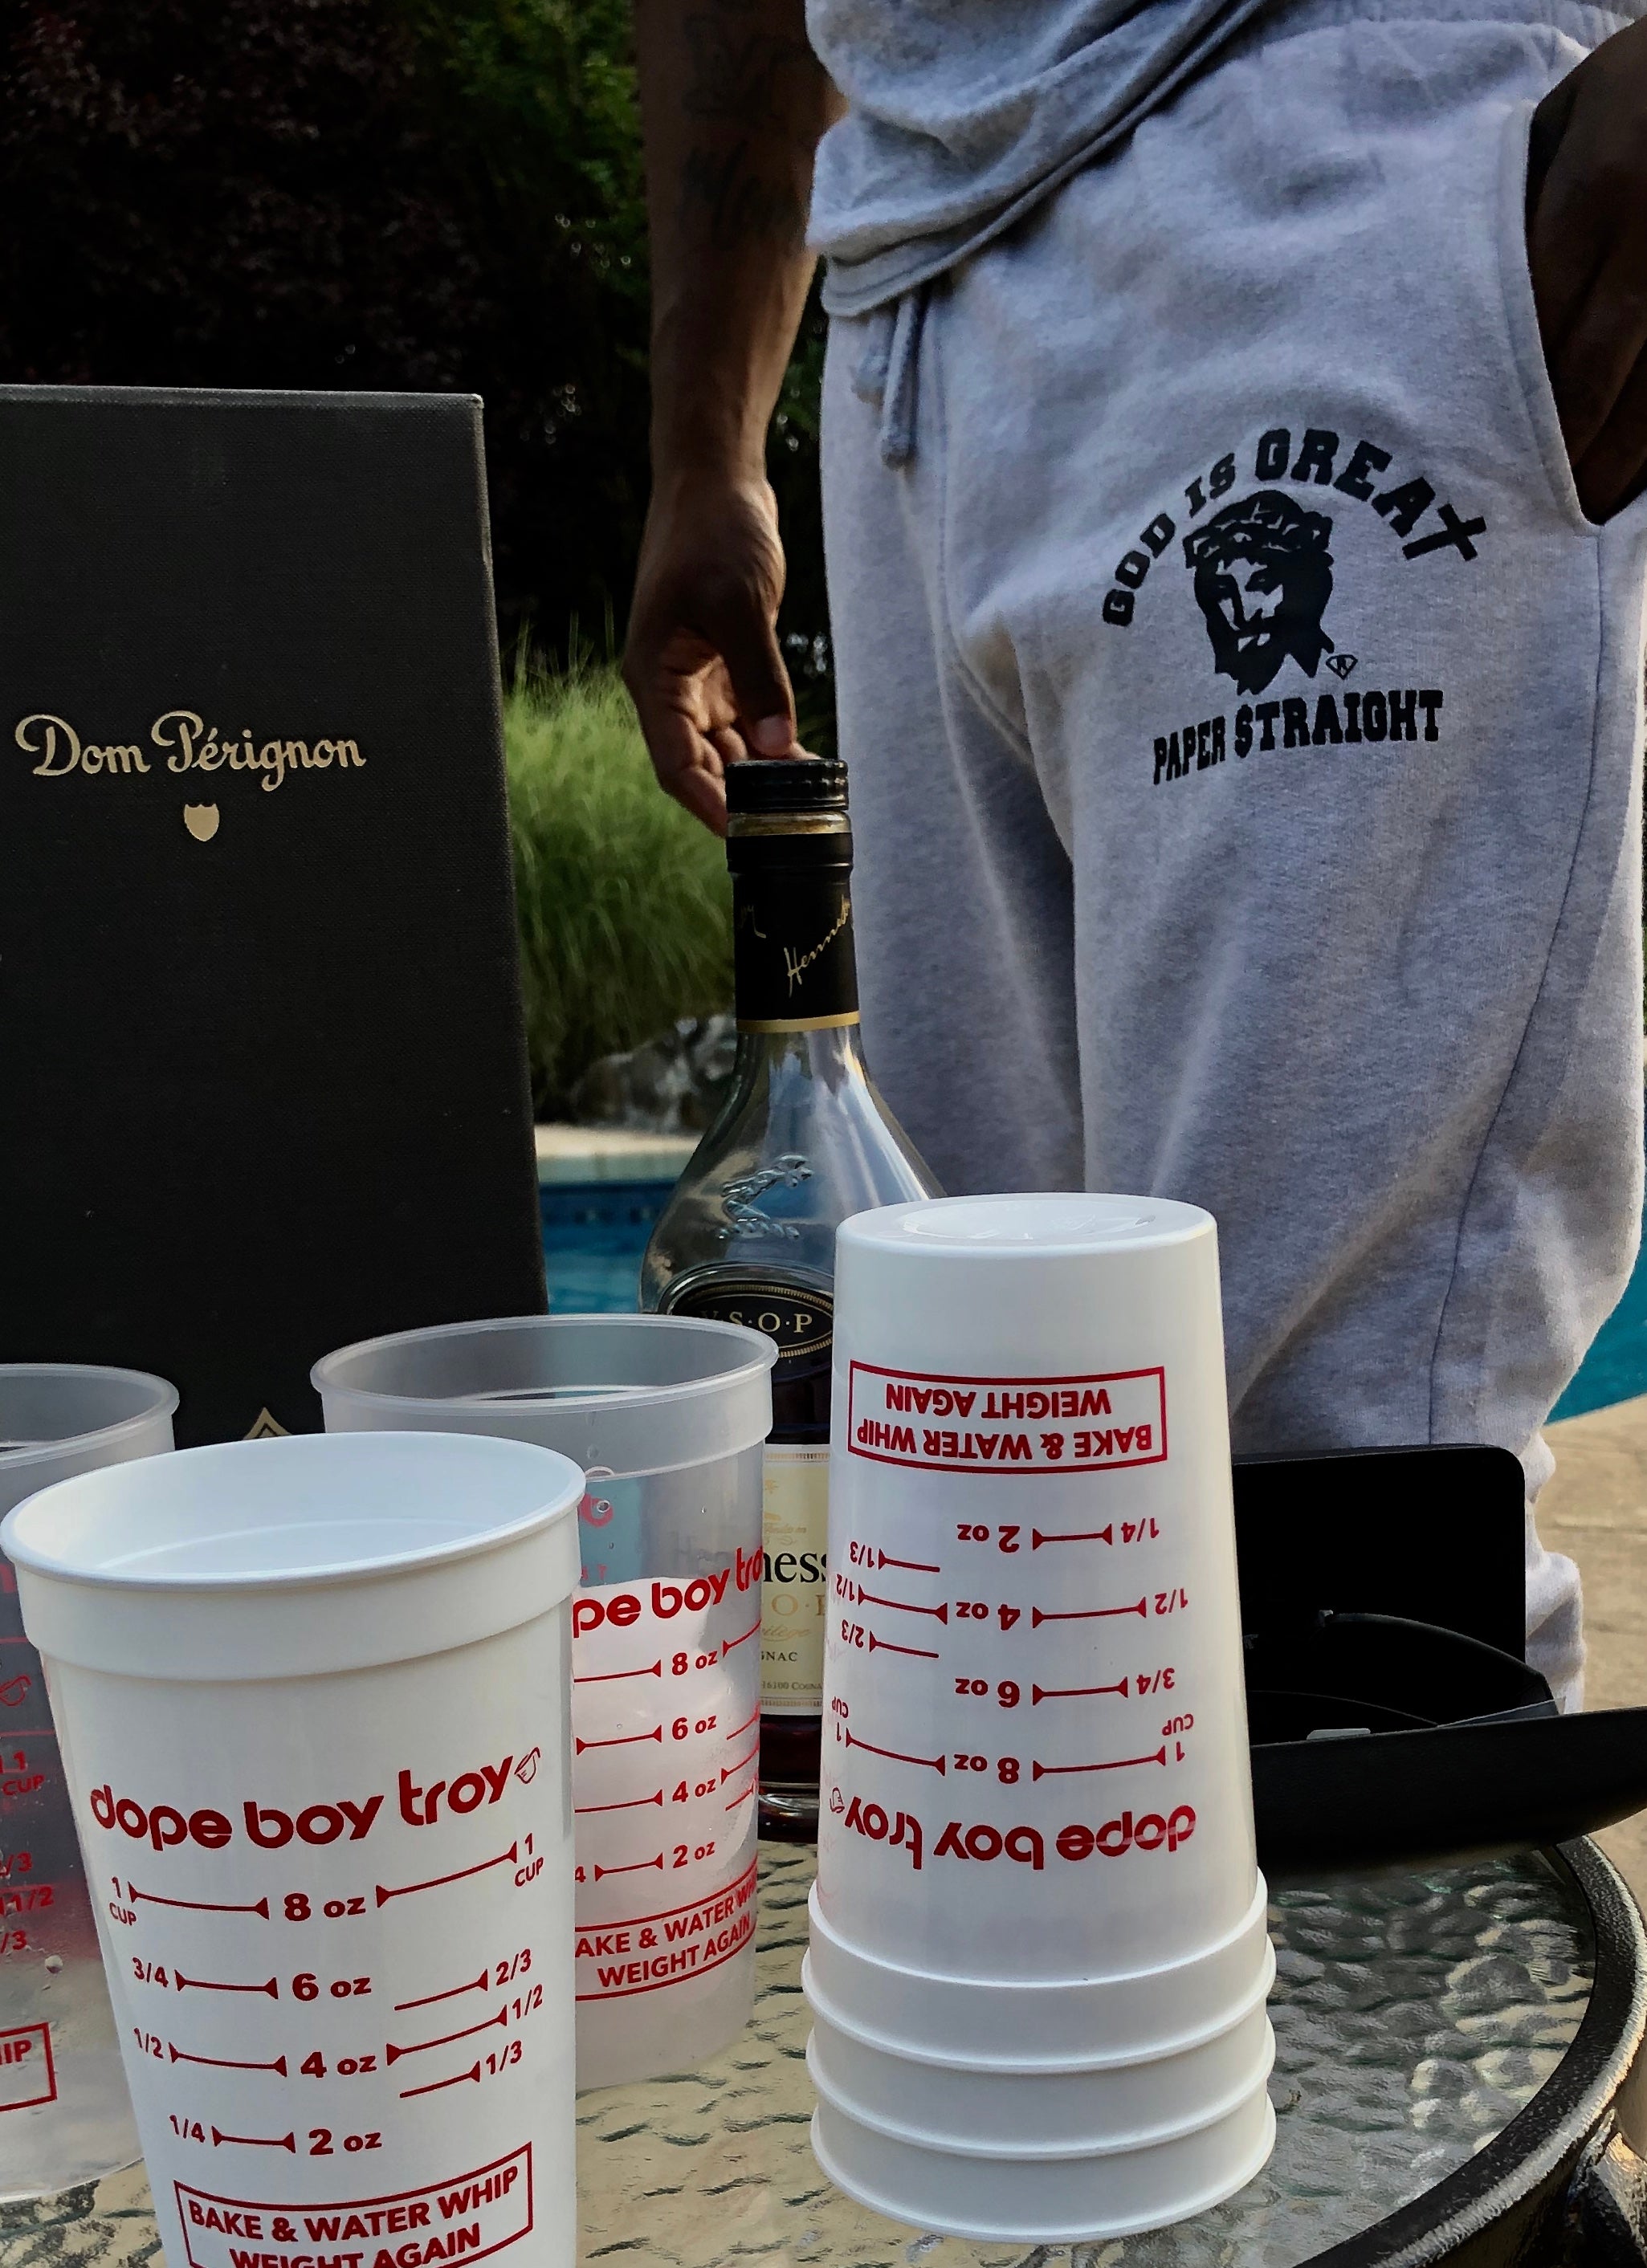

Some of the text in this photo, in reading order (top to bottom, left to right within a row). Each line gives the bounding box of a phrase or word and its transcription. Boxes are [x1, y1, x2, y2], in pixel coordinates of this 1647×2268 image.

[1103, 428, 1486, 627] GOD IS GREAT
[14, 710, 366, 792] Dom Pérignon
[1153, 716, 1225, 784] PAPER
[886, 1384, 1112, 1419] WEIGHT AGAIN
[857, 1420, 1153, 1460] BAKE & WATER WHIP
[850, 1541, 874, 1567] 1/3
[959, 1518, 1160, 1553] 1/4 2 oz
[571, 1593, 642, 1639] pe
[650, 1567, 732, 1620] boy
[837, 1575, 1188, 1631] 1/2 4 oz 1/2
[842, 1621, 864, 1647] 2/3
[671, 1650, 719, 1677] 8 oz
[956, 1667, 1175, 1708] 3/4 6 oz
[831, 1696, 850, 1719] CUP
[1161, 1713, 1194, 1737] CUP
[671, 1714, 717, 1741] 6 oz
[956, 1755, 987, 1771] oz
[997, 1757, 1019, 1783] 8
[1175, 1741, 1185, 1762] 1
[2, 1773, 45, 1797] CUP
[90, 1756, 513, 1851] dope boy troy
[671, 1777, 717, 1803] 4 oz
[845, 1797, 1197, 1870] dope boy troy
[514, 1856, 544, 1887] CUP
[671, 1842, 690, 1870] 2
[693, 1840, 716, 1862] oz
[111, 1833, 534, 1921] 1 8 oz 1
[108, 1902, 137, 1927] CUP
[574, 1931, 632, 1959] AKE
[637, 1926, 658, 1950] &
[663, 1895, 734, 1942] WATER
[596, 1910, 751, 1989] WEIGHT AGAIN
[133, 1948, 532, 2001] 3/4 6 oz 2/3
[133, 1984, 543, 2078] 1/2 4 oz 1/2
[486, 2039, 523, 2075] 1/3
[171, 2116, 381, 2156] 1/4 2 oz
[189, 2164, 519, 2242] BAKE & WATER WHIP
[373, 2223, 481, 2268] AGAIN
